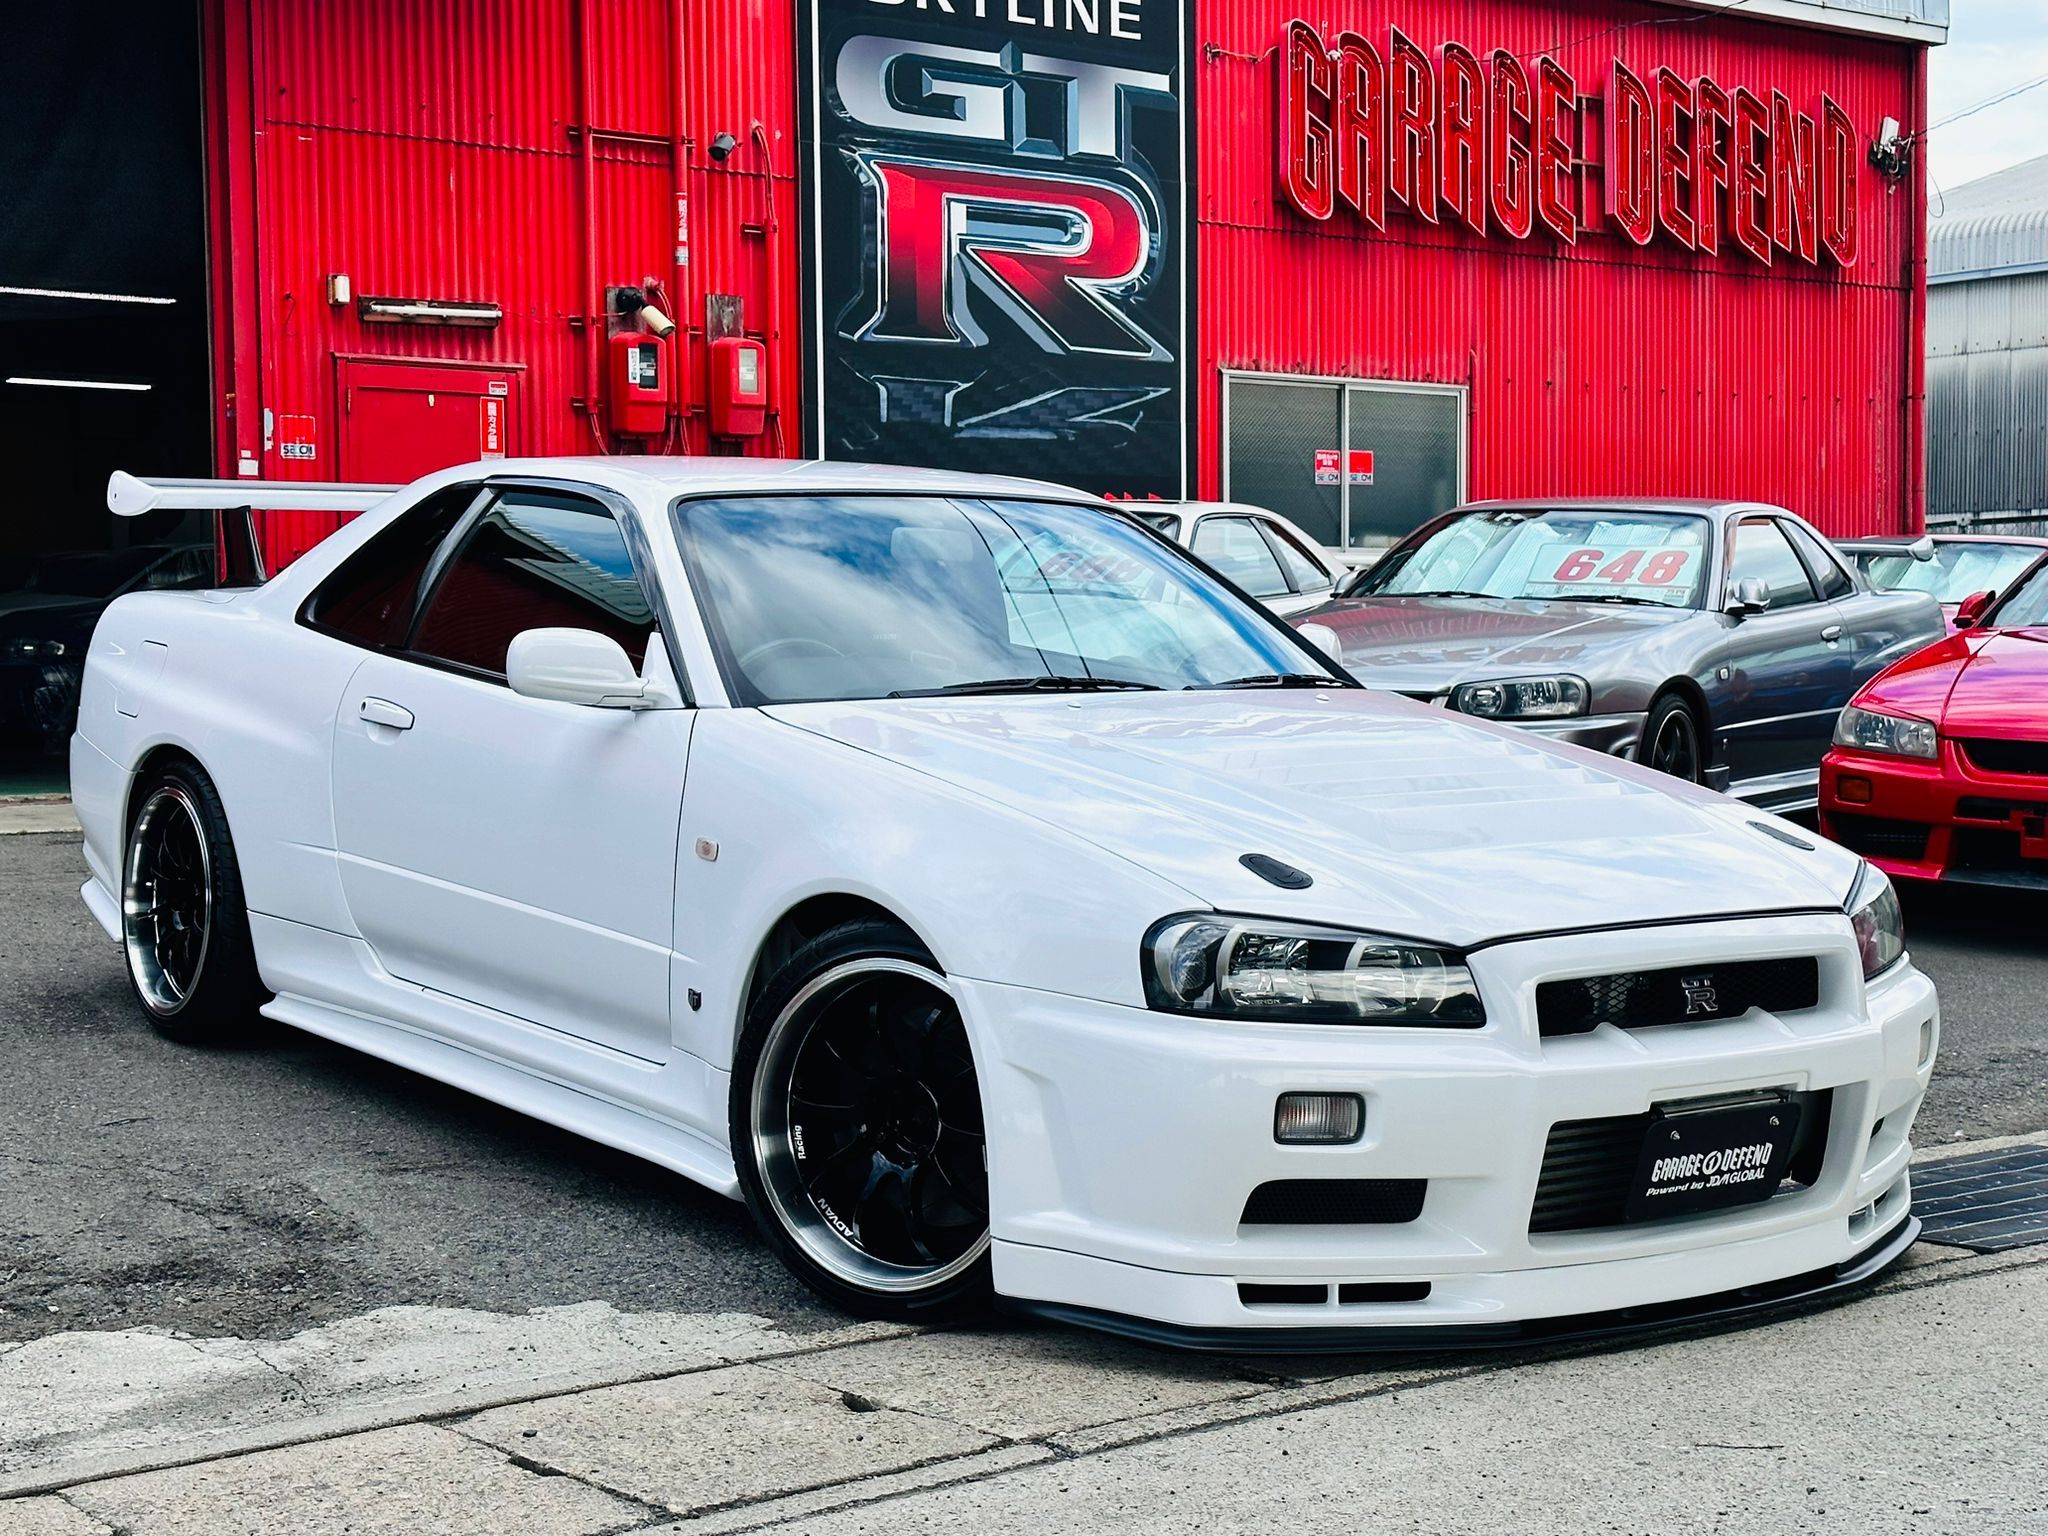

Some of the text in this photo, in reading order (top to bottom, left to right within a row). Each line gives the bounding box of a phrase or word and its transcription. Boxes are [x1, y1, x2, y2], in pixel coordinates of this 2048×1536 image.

[867, 0, 1142, 40] LINE
[836, 35, 1172, 162] GT
[1282, 18, 1859, 268] GARAGE DEFEND
[1552, 549, 1690, 585] 648
[794, 1125, 853, 1237] ADVAN Racing
[1651, 1142, 1773, 1182] GARAGE DEFEND
[1646, 1183, 1689, 1197] Powered
